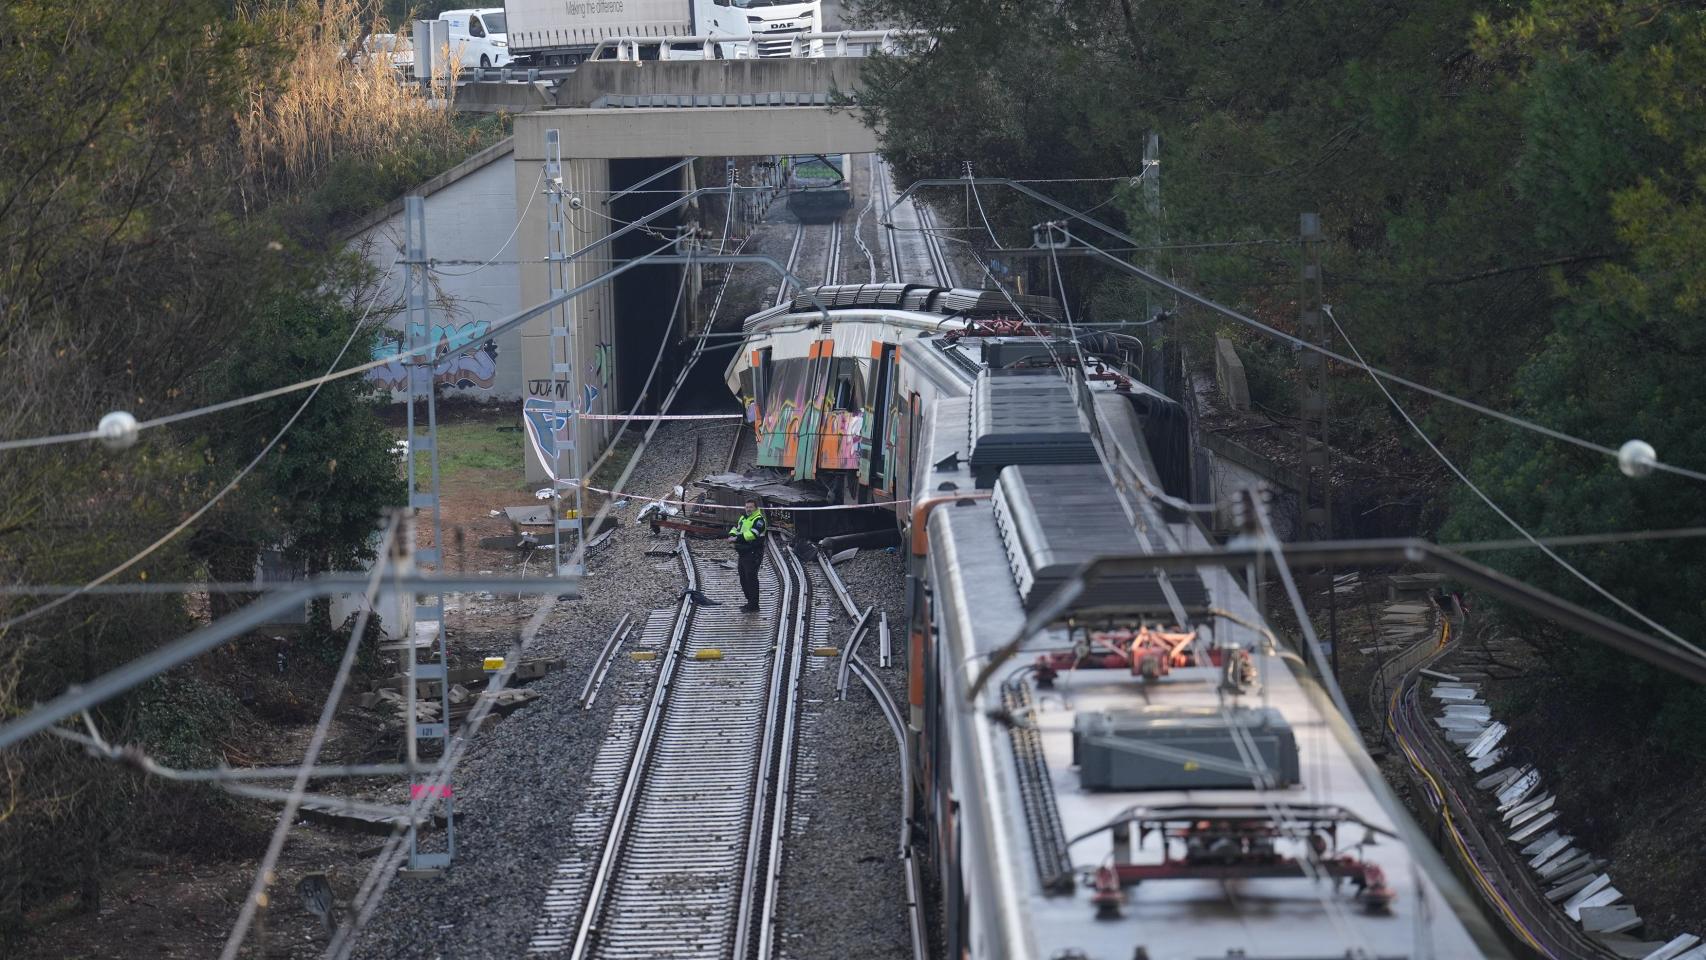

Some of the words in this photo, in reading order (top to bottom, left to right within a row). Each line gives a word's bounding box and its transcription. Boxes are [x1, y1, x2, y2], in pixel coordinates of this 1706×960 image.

[565, 1, 586, 18] Making
[586, 0, 596, 14] the
[596, 0, 624, 14] difference
